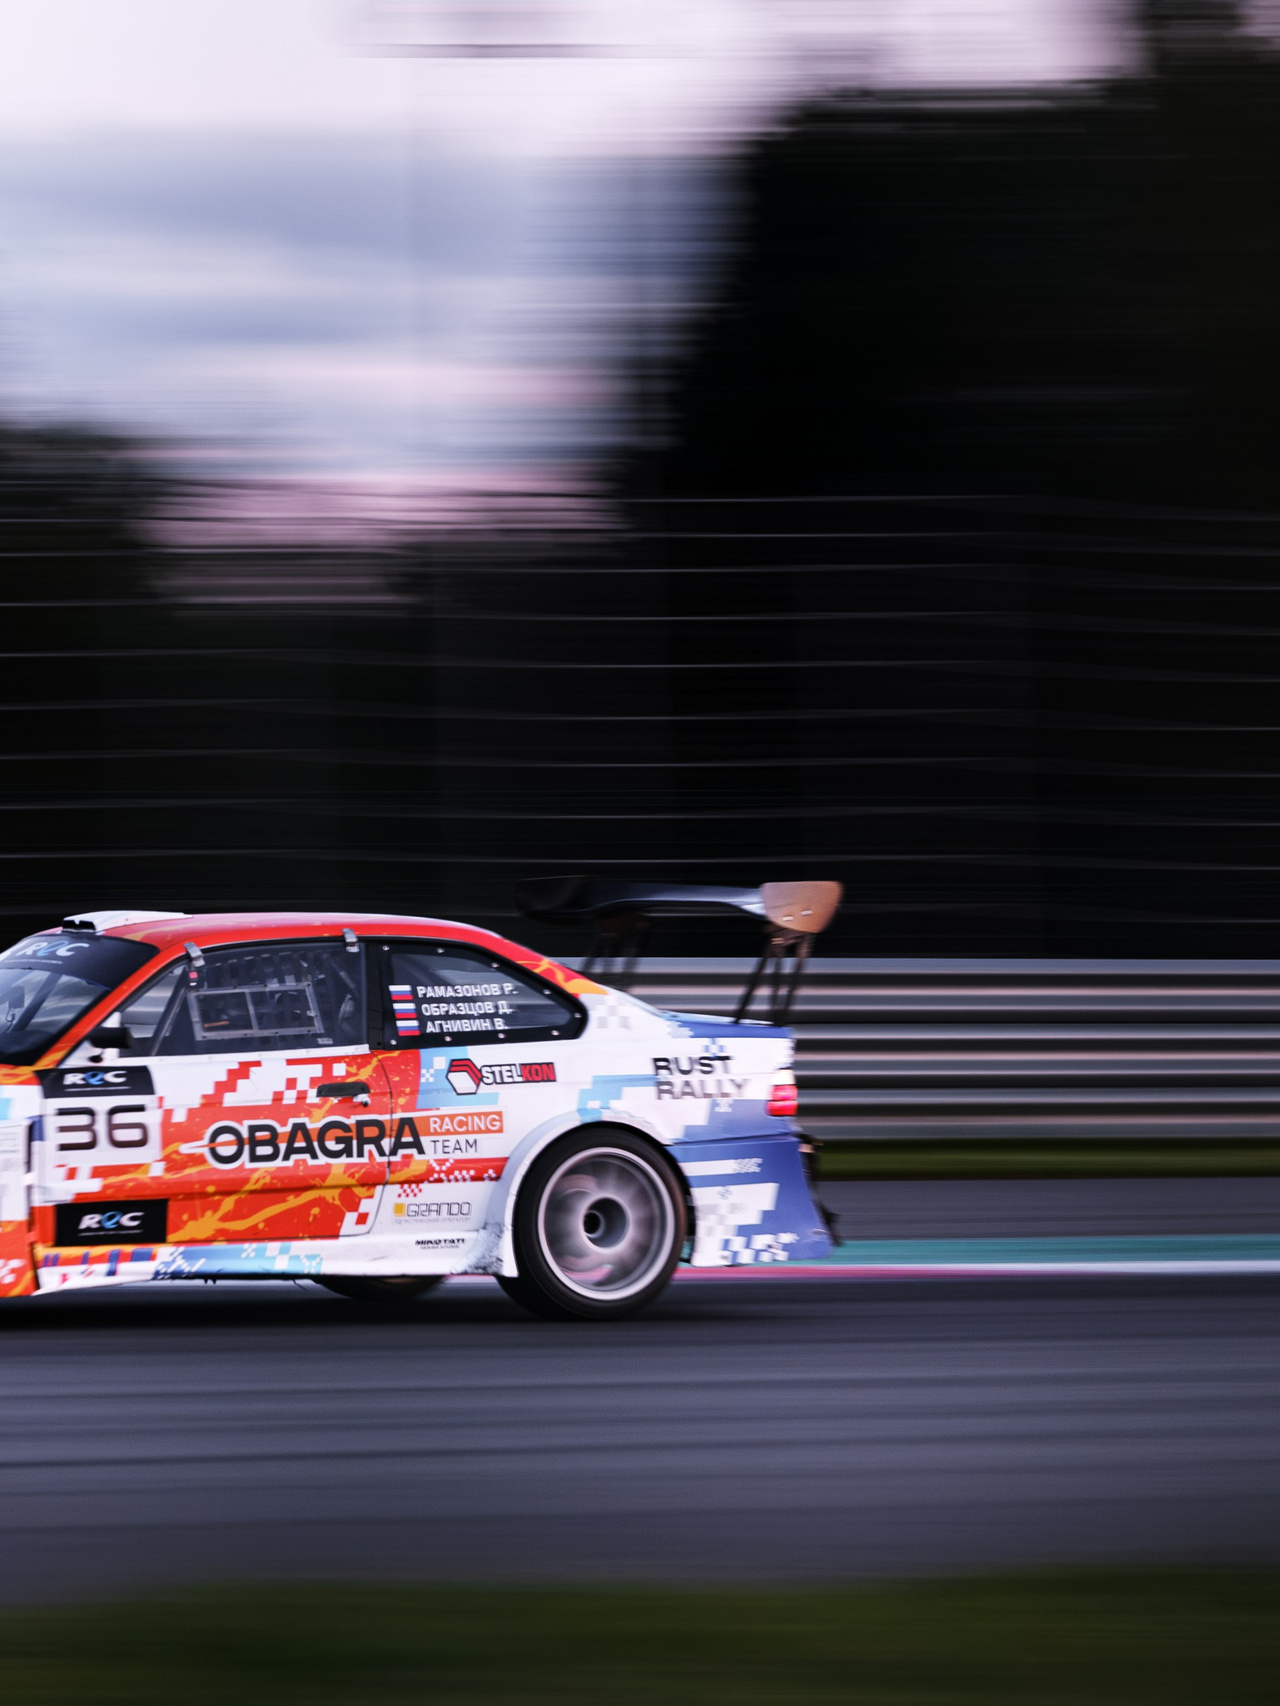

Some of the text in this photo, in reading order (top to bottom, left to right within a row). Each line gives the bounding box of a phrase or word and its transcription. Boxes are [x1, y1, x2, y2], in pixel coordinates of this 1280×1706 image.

[417, 983, 519, 998] РАМАЗОНОВ Р.
[421, 1001, 495, 1016] ОБРАЗЦОВ
[426, 1018, 510, 1033] АГНИВИН В.
[480, 1062, 556, 1085] STELKON
[652, 1055, 732, 1076] RUST
[656, 1078, 751, 1100] RALLY
[56, 1104, 149, 1151] 36
[429, 1114, 501, 1133] RACING
[209, 1117, 426, 1164] OBAGRA
[430, 1138, 478, 1154] TEAM
